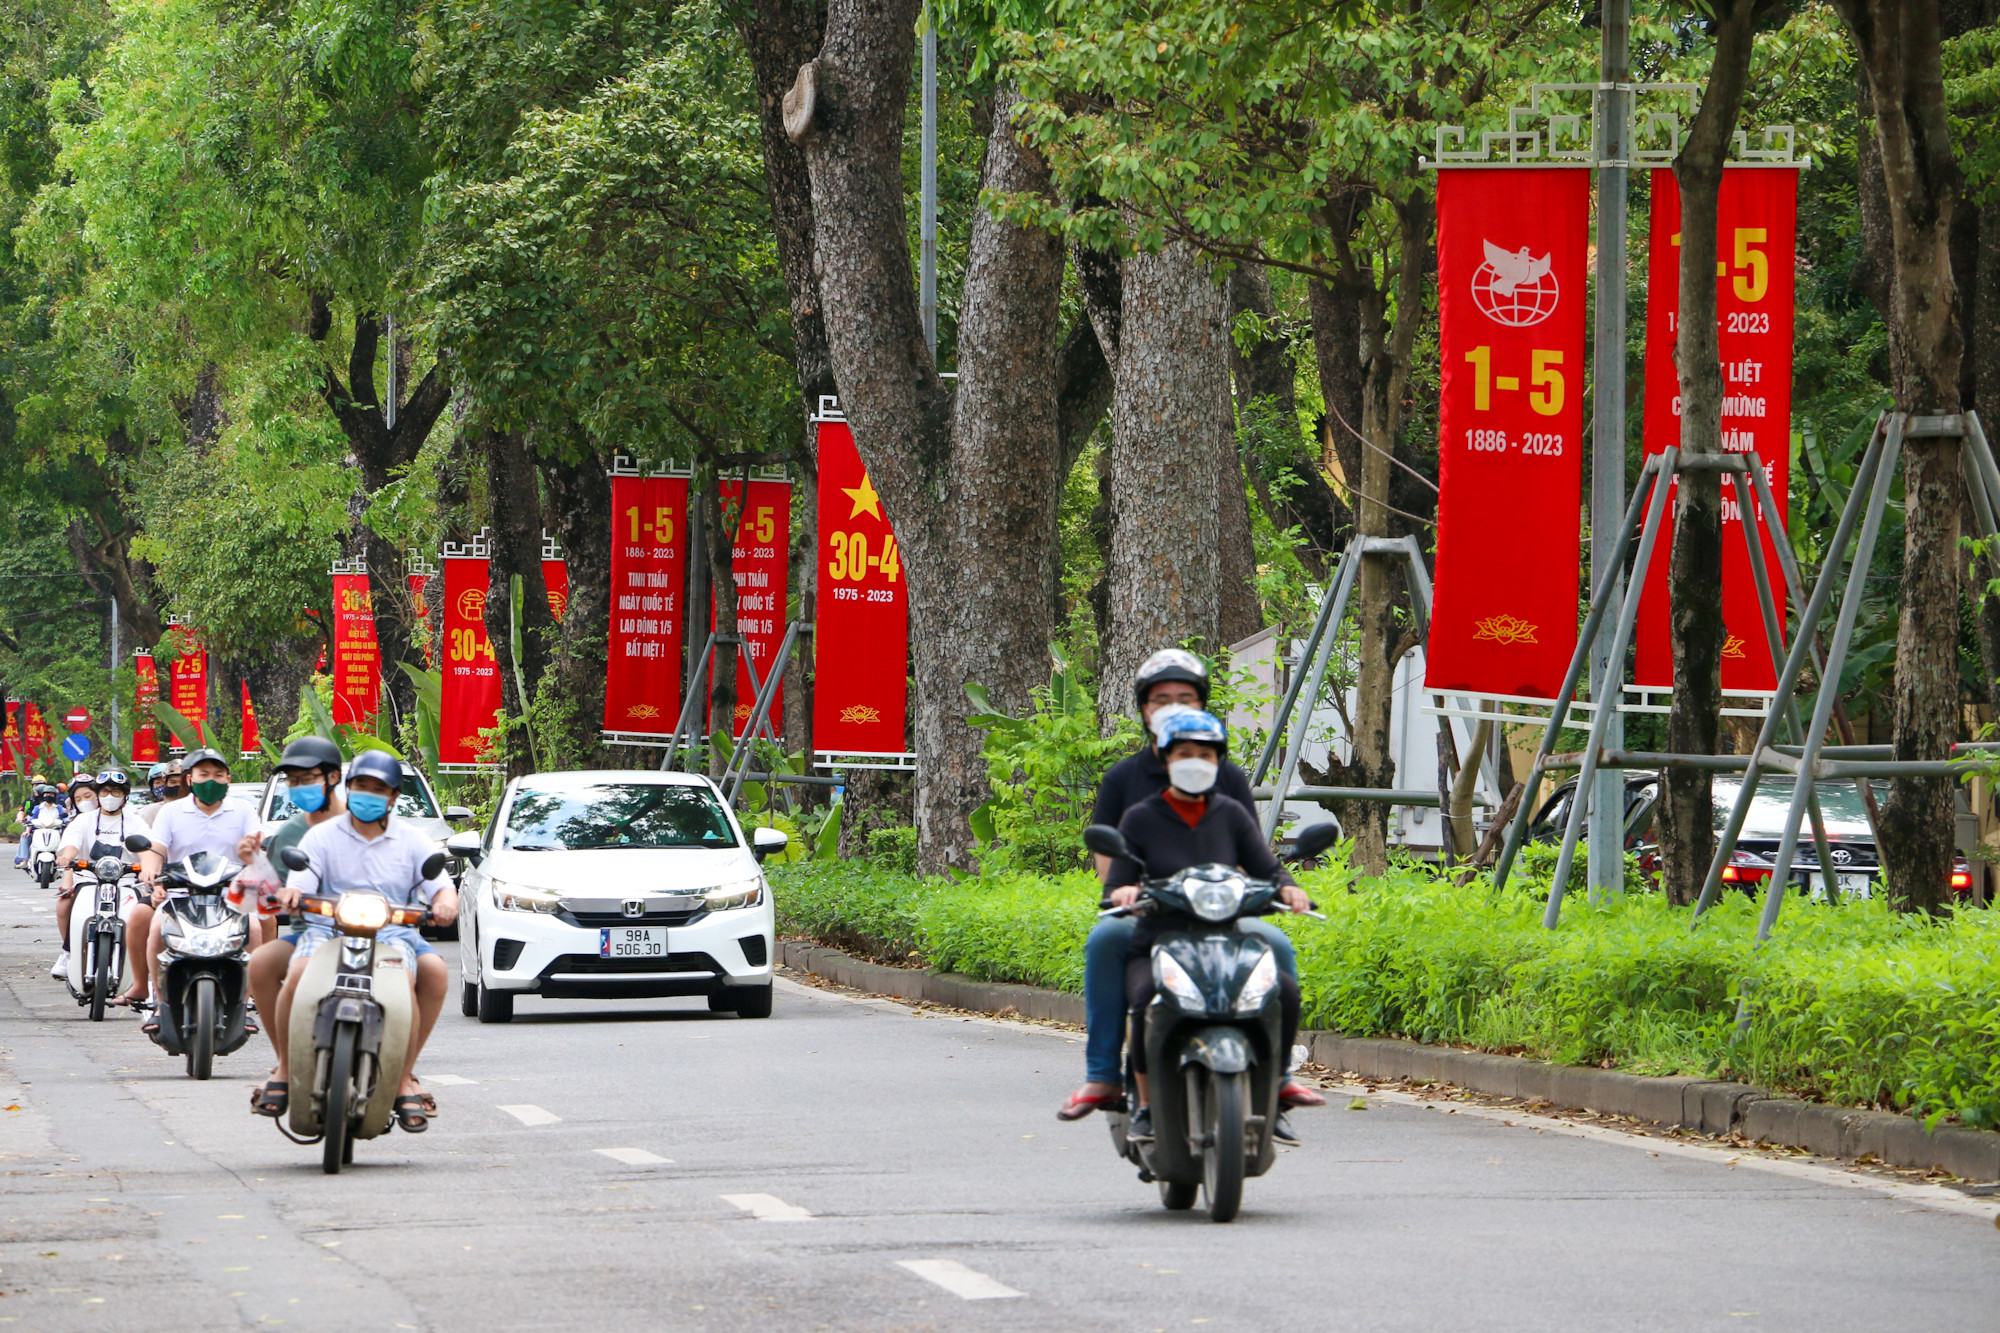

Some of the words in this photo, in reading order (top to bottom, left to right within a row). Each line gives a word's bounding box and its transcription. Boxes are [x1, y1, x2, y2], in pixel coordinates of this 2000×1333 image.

[1727, 312, 1770, 334] 2023
[1465, 346, 1565, 416] 1-5
[1729, 358, 1762, 387] LIỆT
[1721, 392, 1766, 417] MỪNG
[1465, 429, 1506, 453] 1886
[1522, 432, 1563, 456] 2023
[626, 506, 674, 544] 1-5
[625, 547, 645, 558] 1886
[653, 548, 674, 559] 2023
[753, 547, 775, 558] 2023
[829, 531, 899, 582] 30-4
[628, 572, 646, 587] TINH
[647, 569, 668, 588] THẦN
[748, 568, 768, 588] THẦN
[619, 592, 640, 610] NGÀY
[642, 592, 663, 612] QUỐC
[664, 592, 675, 611] TẾ
[742, 591, 763, 611] QUỐC
[765, 592, 775, 611] TẾ
[833, 588, 858, 600] 1975
[867, 589, 893, 602] 2023
[620, 618, 635, 633] LAO
[637, 616, 658, 637] ĐỘNG
[660, 620, 672, 635] 1/5
[761, 620, 773, 634] 1/5
[626, 637, 641, 657] BẤT
[643, 640, 660, 660] DIỆT
[661, 643, 665, 657] !
[175, 658, 202, 673] 7-5
[454, 667, 470, 675] 1975
[476, 667, 493, 676] 2023
[626, 930, 650, 941] 98A
[616, 943, 661, 955] 506.30
